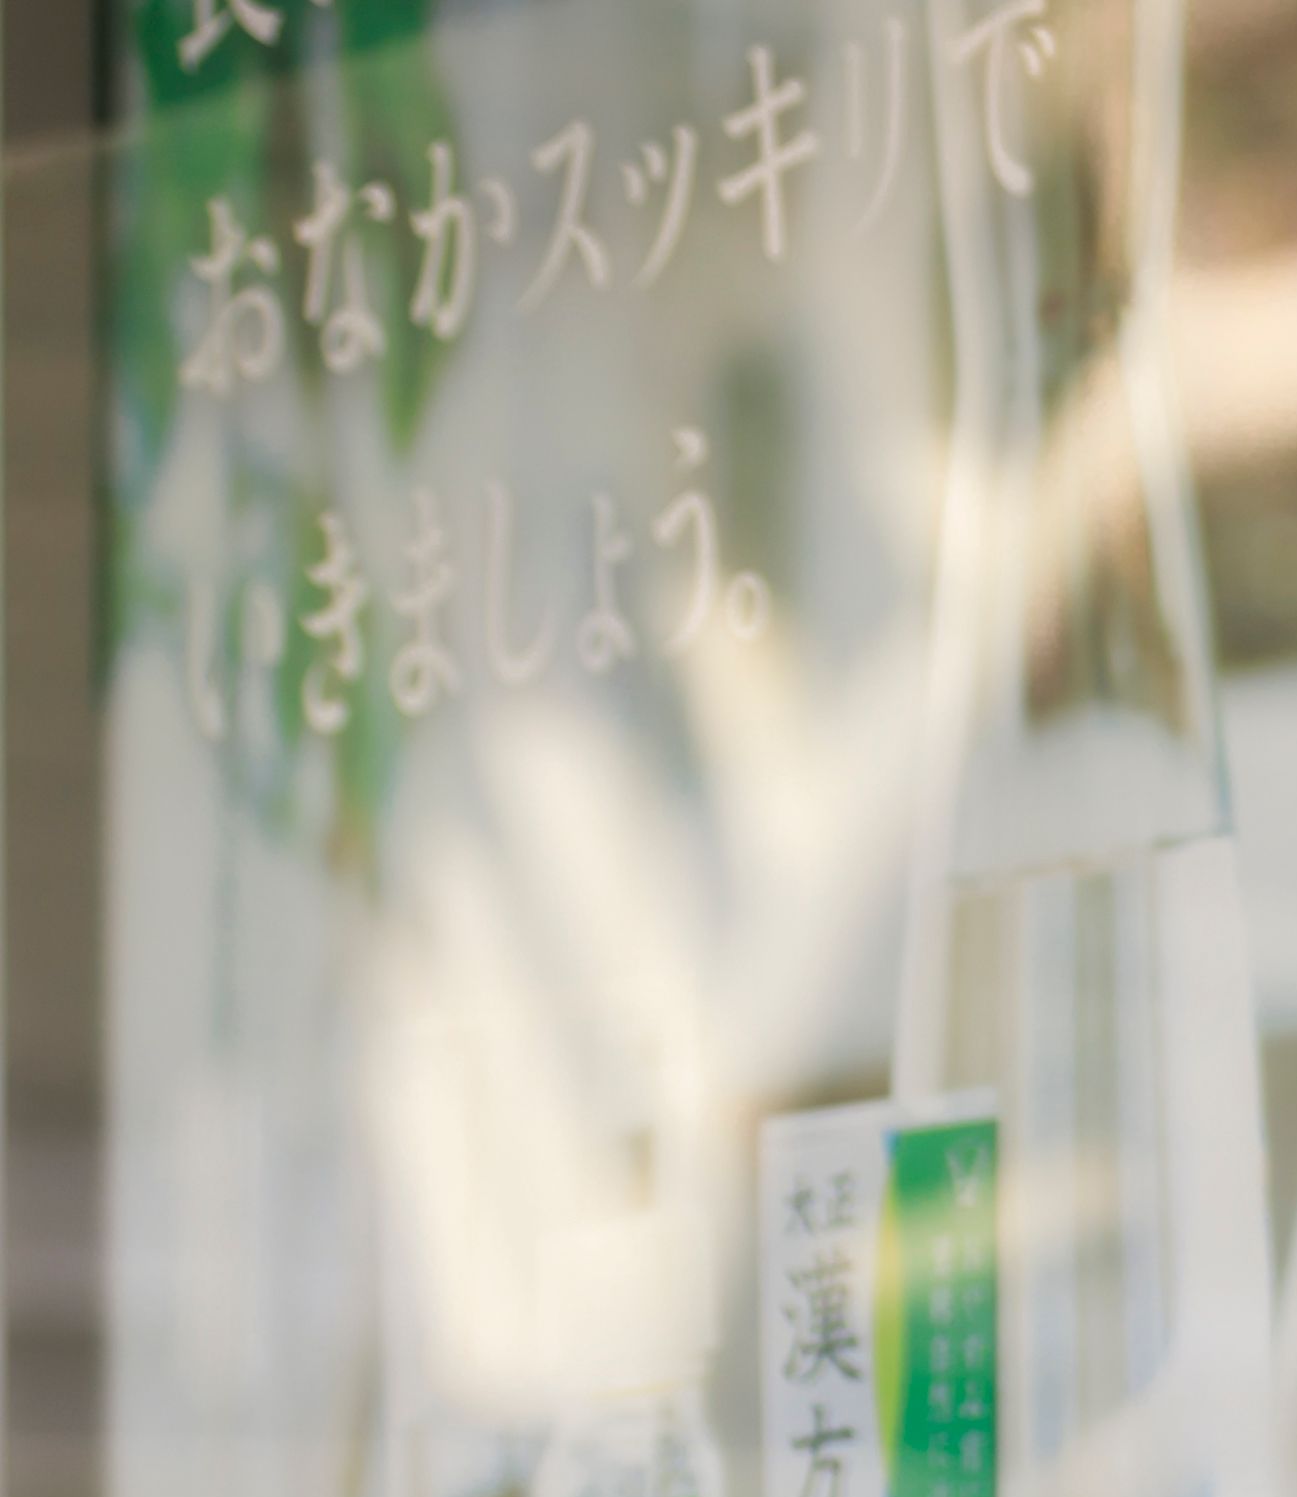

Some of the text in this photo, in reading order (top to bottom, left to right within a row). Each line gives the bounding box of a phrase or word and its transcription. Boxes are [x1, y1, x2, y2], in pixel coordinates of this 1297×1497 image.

[180, 2, 1060, 394] おなかスッキリで
